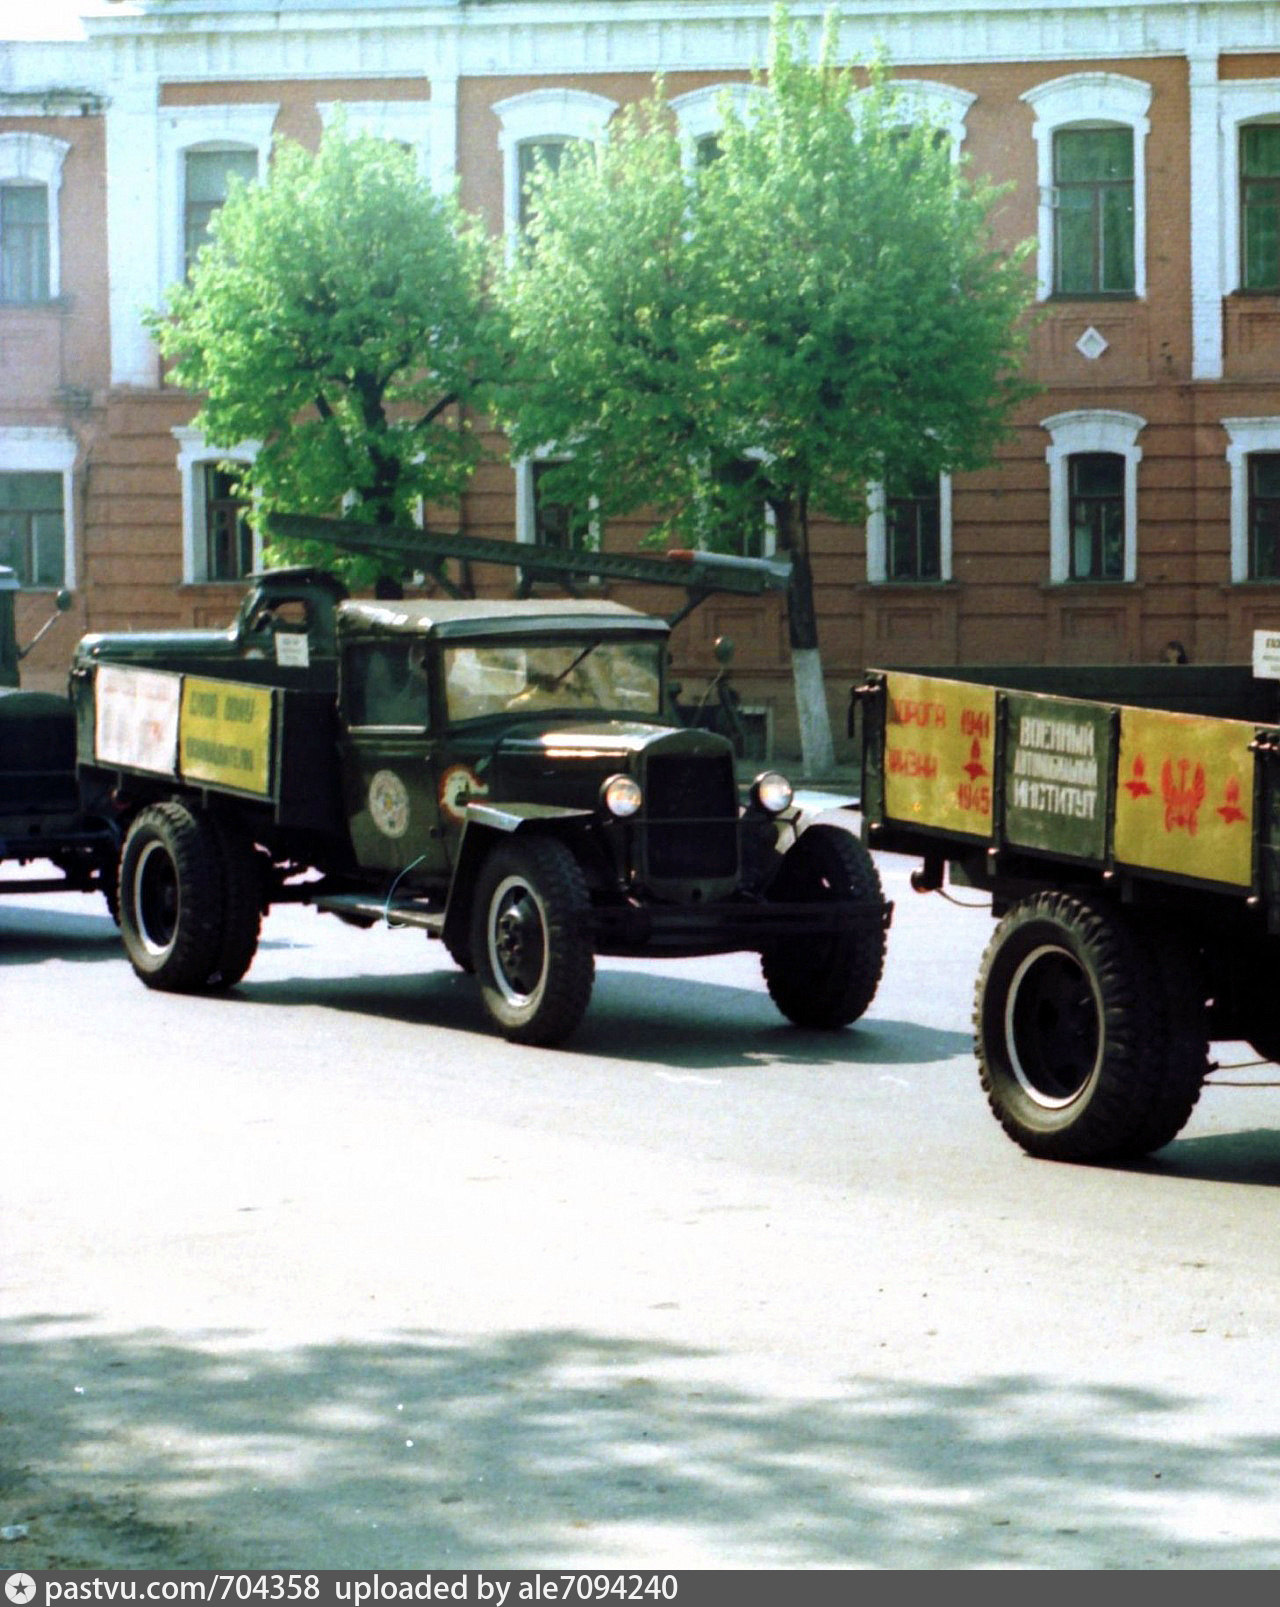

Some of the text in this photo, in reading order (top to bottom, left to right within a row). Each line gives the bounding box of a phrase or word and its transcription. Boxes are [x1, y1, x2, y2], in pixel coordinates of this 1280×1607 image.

[960, 708, 990, 739] 1941
[1019, 716, 1095, 757] ВОЕННЫЙ
[957, 782, 990, 815] 1945
[1014, 778, 1097, 820] ИНСТИТУТ
